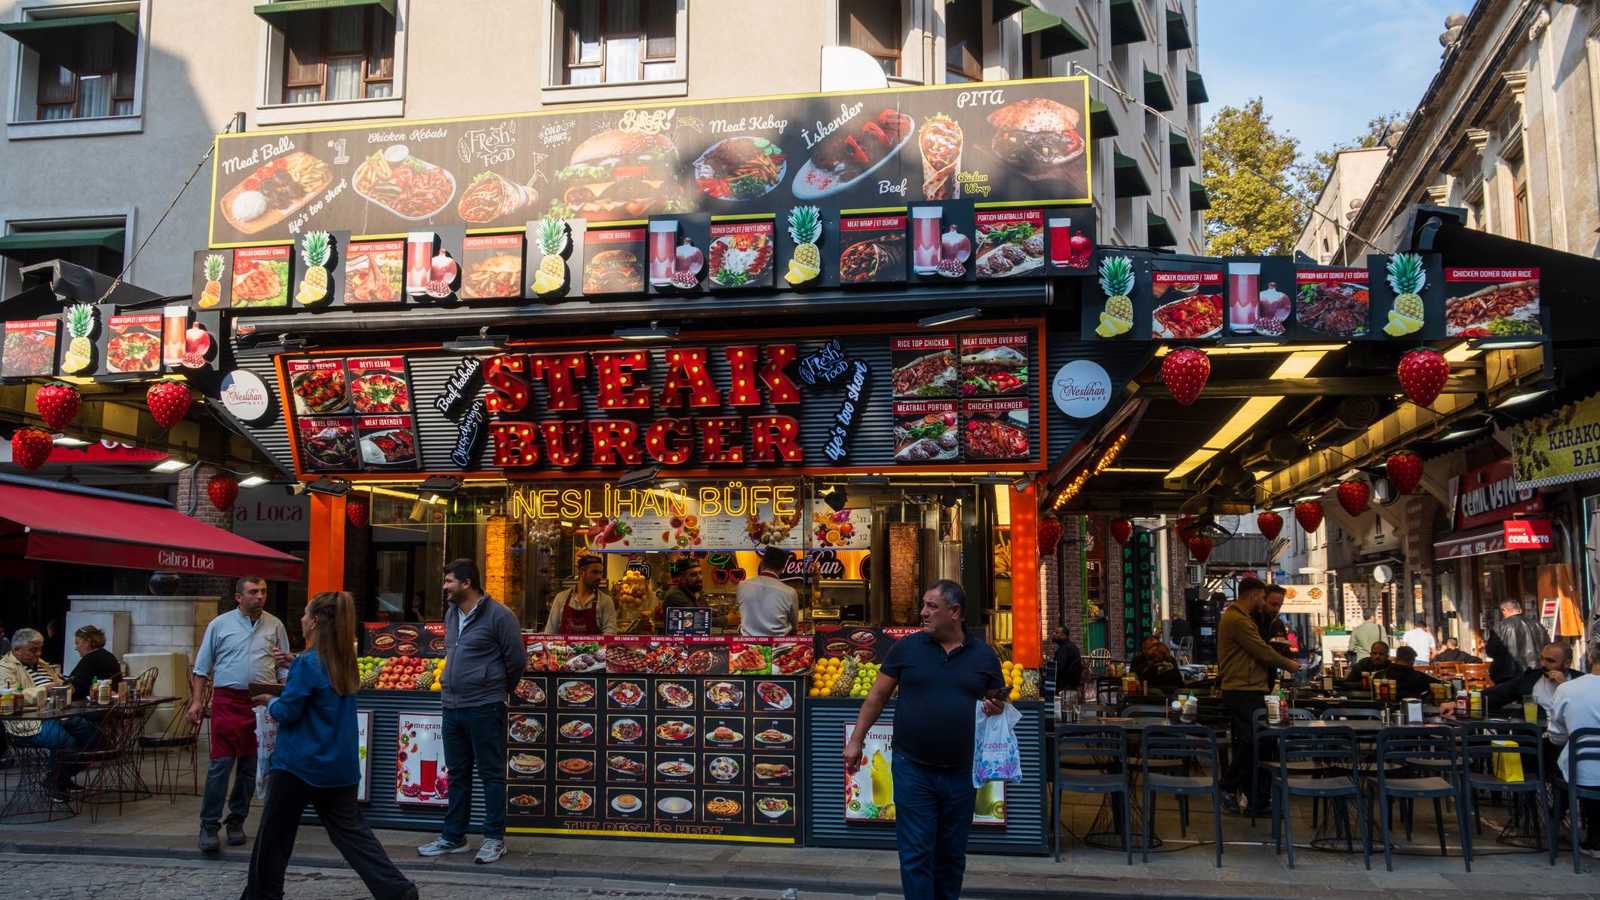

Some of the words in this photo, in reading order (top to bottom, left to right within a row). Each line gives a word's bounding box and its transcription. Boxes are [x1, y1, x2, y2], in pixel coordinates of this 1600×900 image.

[957, 90, 1006, 109] PITA
[709, 119, 746, 134] Meat
[748, 113, 788, 135] Kebap
[801, 101, 864, 150] İskender
[222, 149, 260, 175] Meat
[260, 136, 295, 161] Balls
[878, 179, 908, 196] Beef
[483, 344, 801, 413] STEAK
[837, 401, 855, 425] too
[847, 360, 868, 401] short
[488, 415, 804, 467] BURGER
[257, 502, 303, 521] Loca
[513, 483, 688, 519] NESLİHAN
[698, 481, 797, 518] BÜFE
[158, 551, 189, 568] Cabra
[191, 554, 215, 569] Loca
